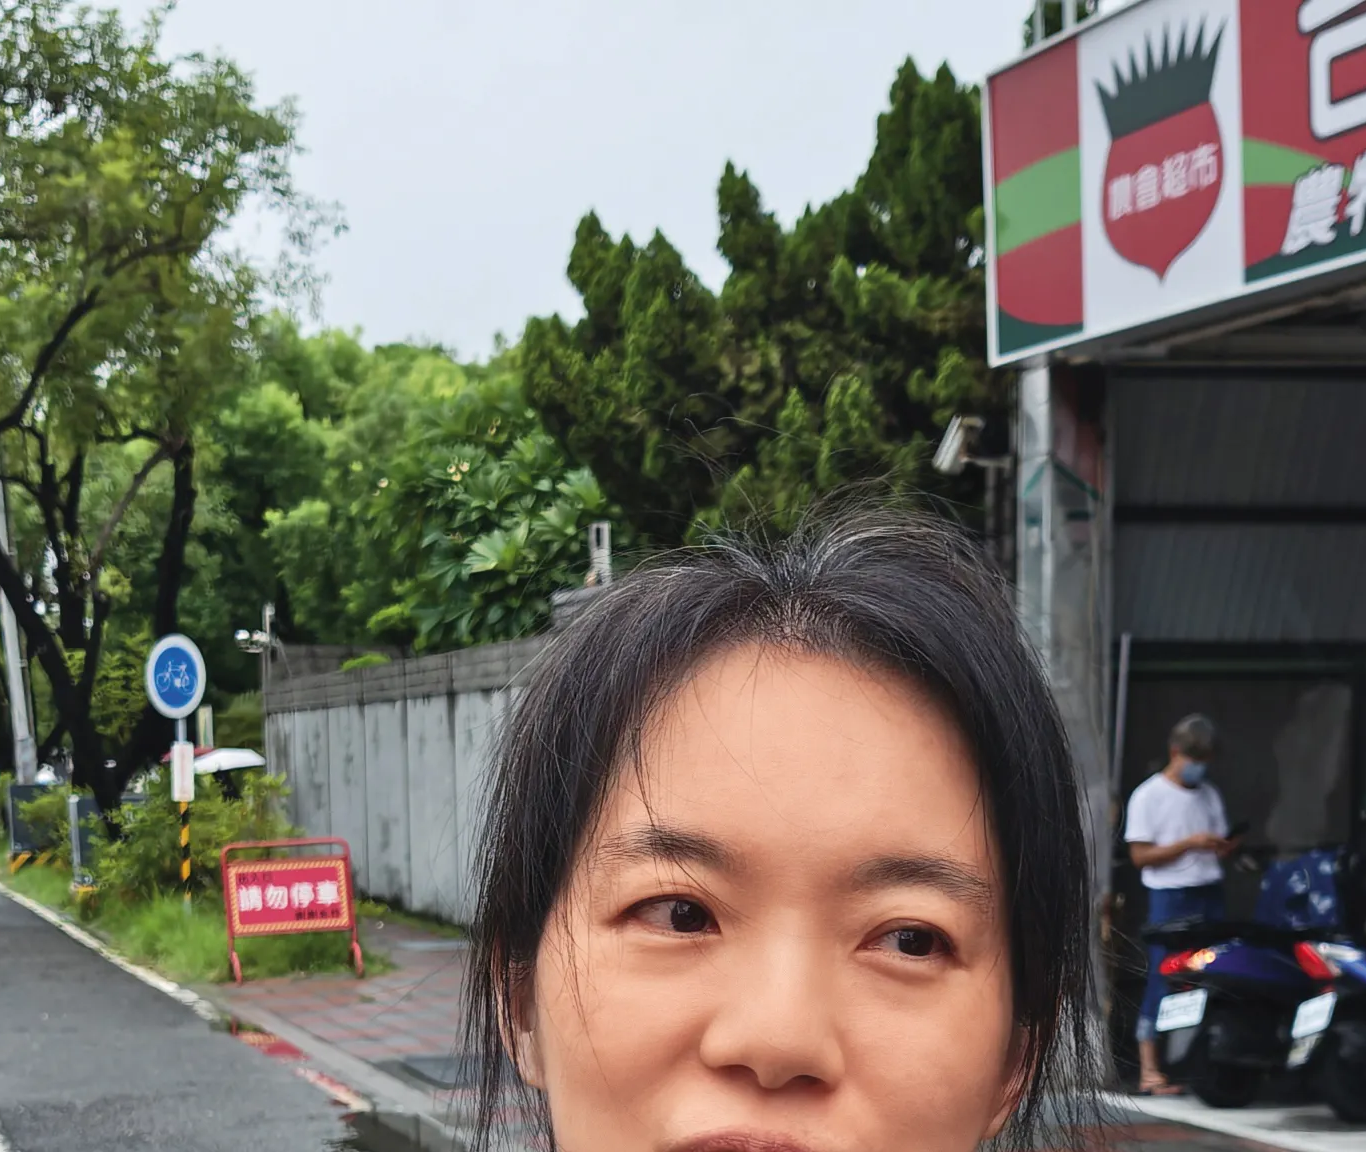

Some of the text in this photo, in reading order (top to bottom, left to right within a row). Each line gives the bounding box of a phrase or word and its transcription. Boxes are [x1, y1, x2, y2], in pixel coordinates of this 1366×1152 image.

[1107, 142, 1219, 222] 農會超市
[238, 880, 339, 912] 請勿停車
